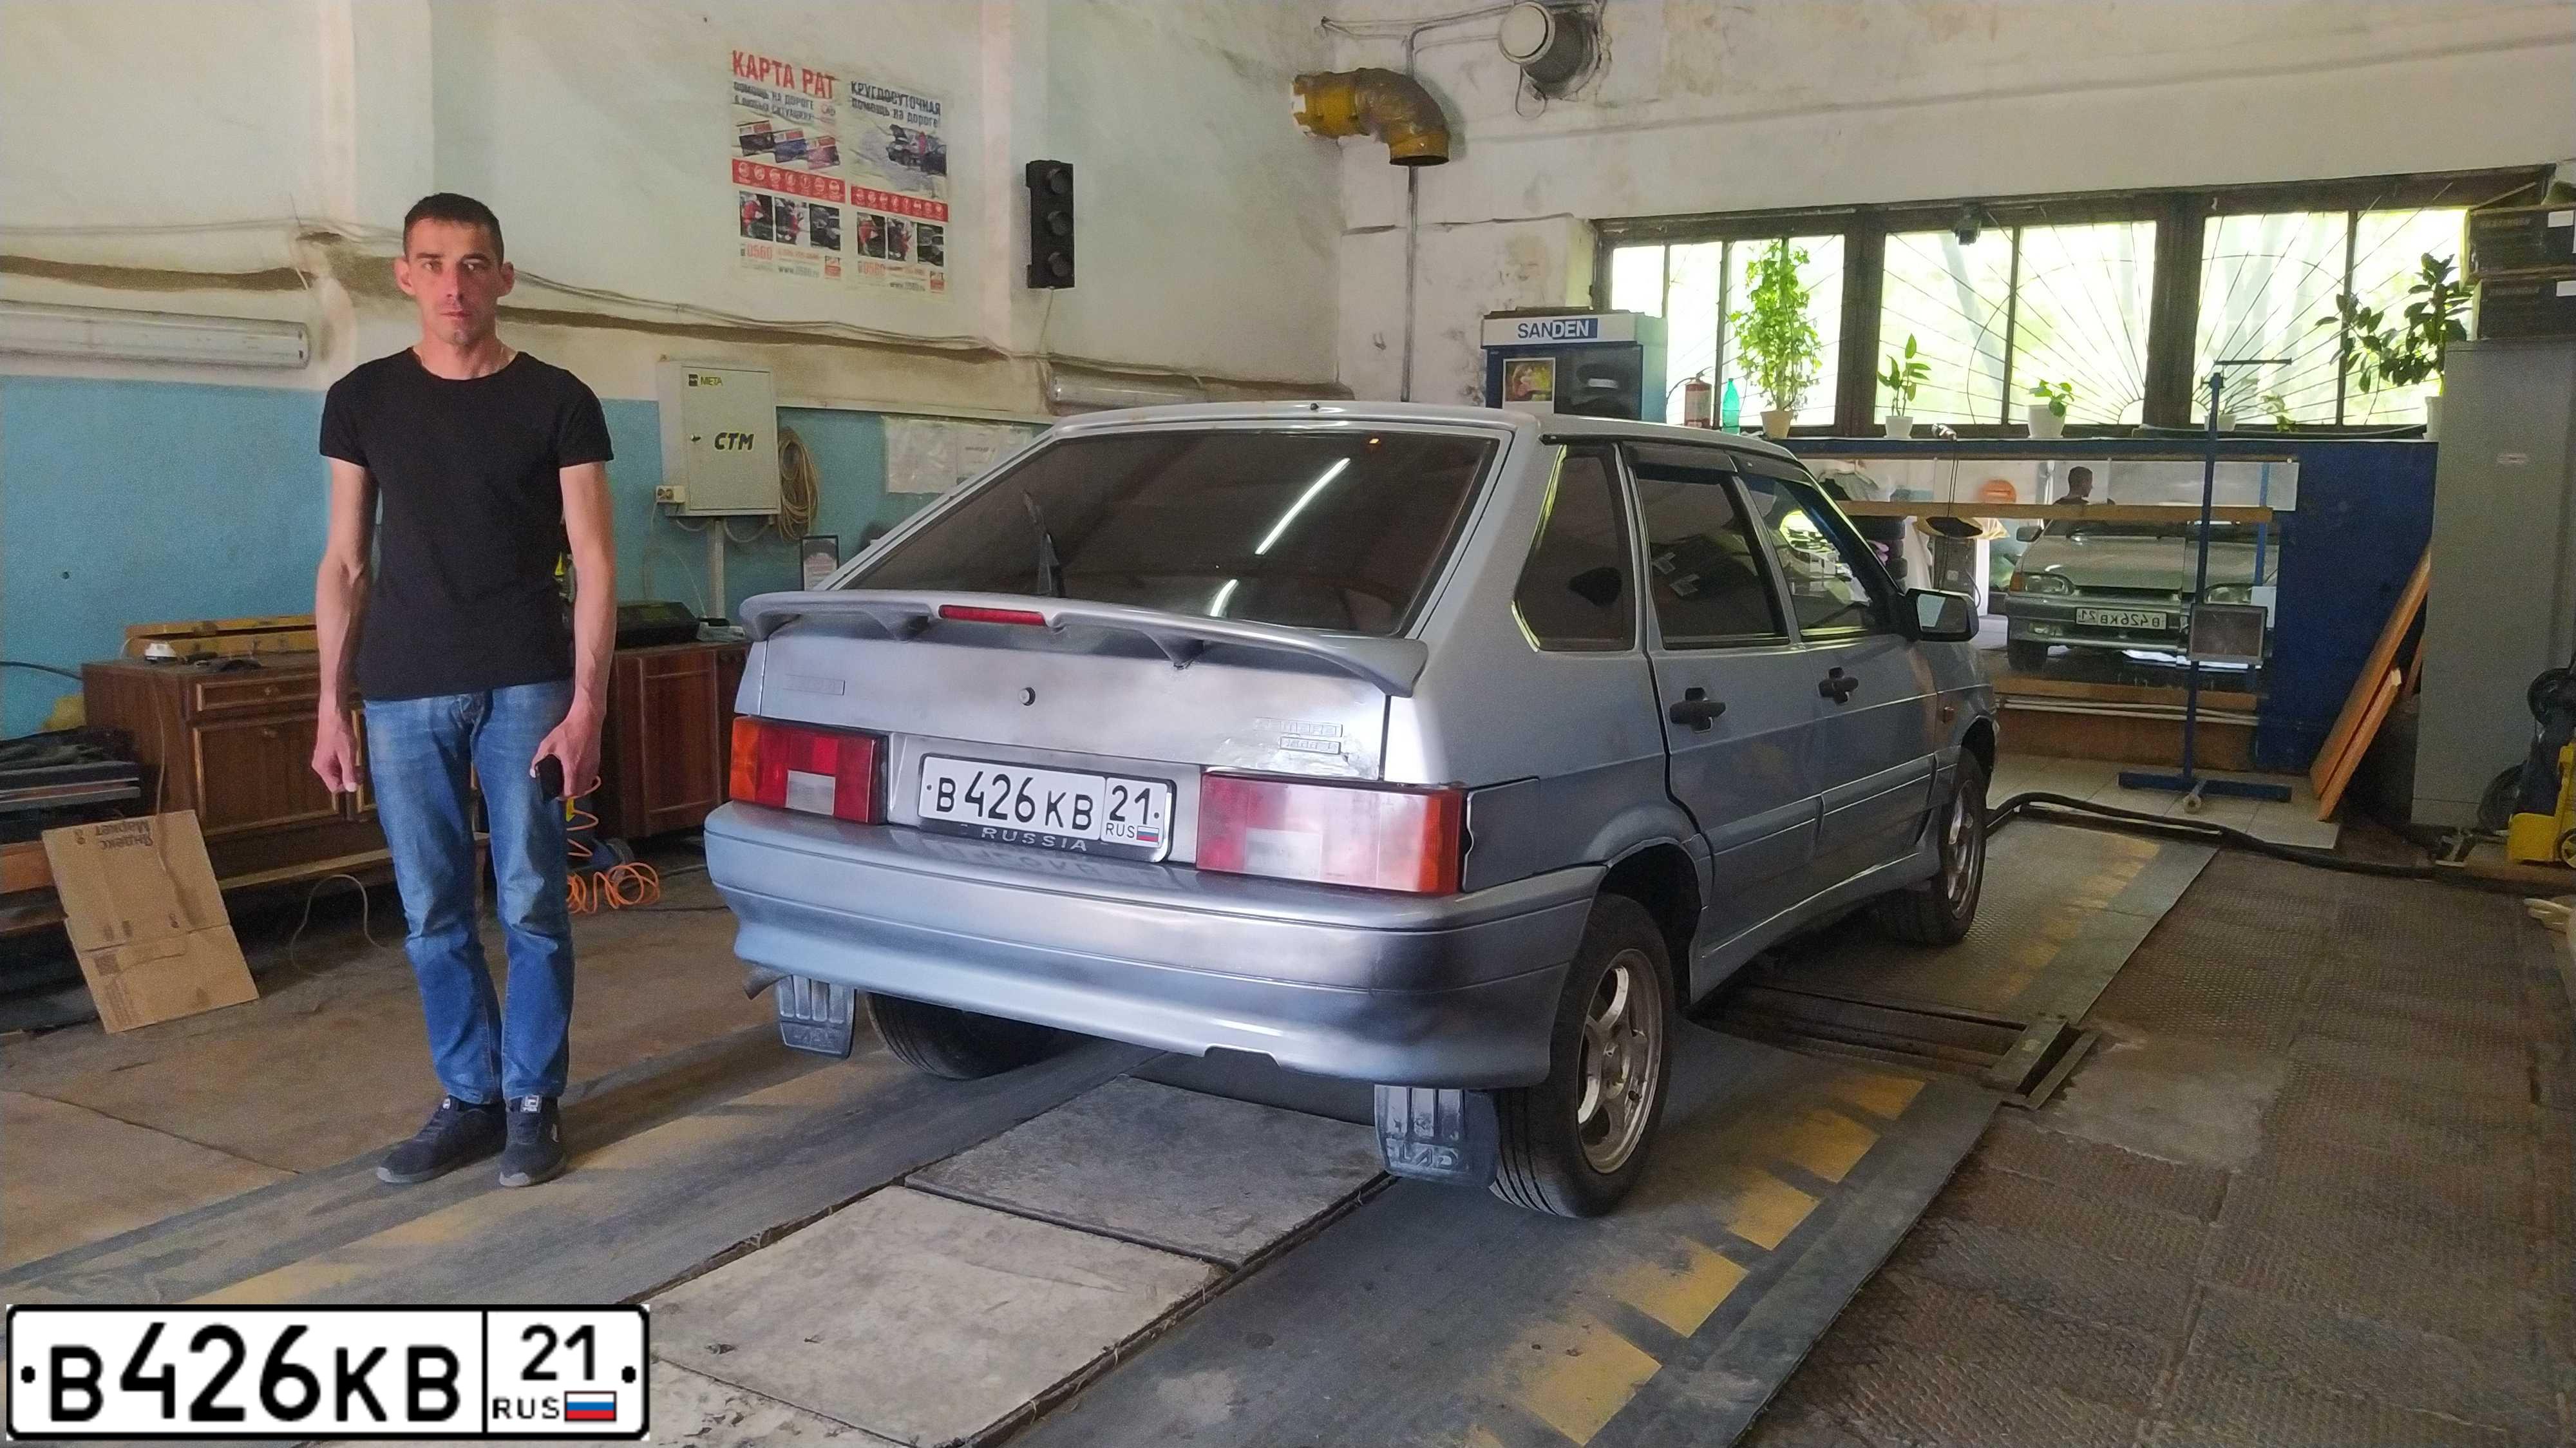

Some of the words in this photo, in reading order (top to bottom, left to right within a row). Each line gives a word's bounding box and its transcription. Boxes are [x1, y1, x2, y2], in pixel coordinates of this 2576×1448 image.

[732, 50, 795, 90] КАРТА
[802, 68, 833, 99] РАТ
[851, 81, 941, 115] КРУГЛОСУТОЧНАЯ
[907, 111, 938, 128] дороге
[1517, 319, 1589, 338] SANDEN
[936, 770, 1094, 831] В426КВ
[1109, 785, 1151, 824] 21
[981, 827, 1088, 852] RUSSIA
[1105, 822, 1135, 839] RUS
